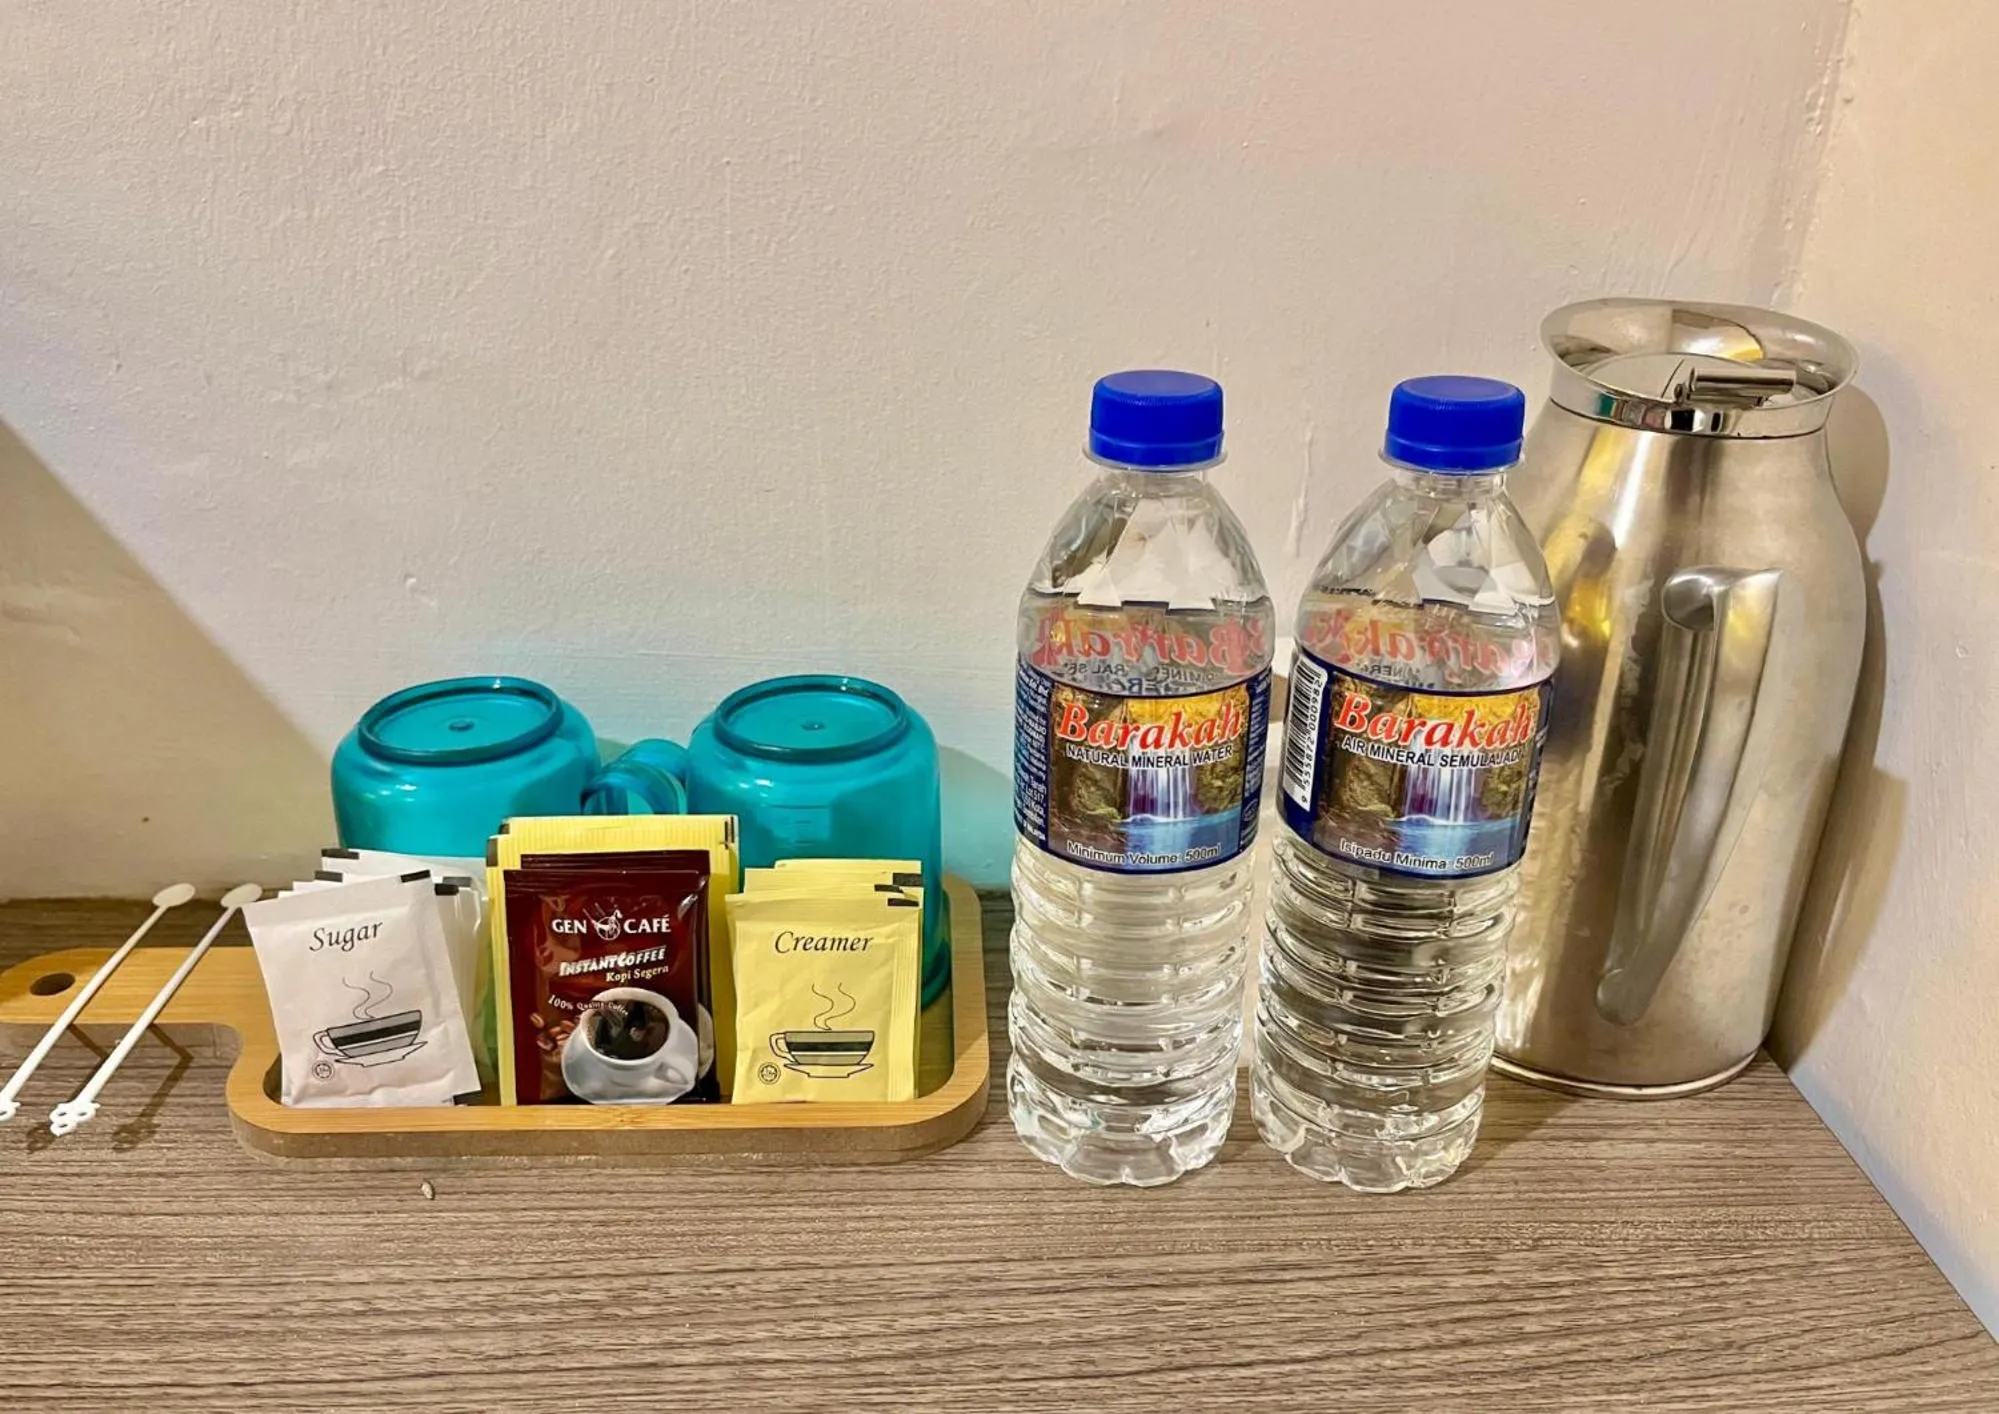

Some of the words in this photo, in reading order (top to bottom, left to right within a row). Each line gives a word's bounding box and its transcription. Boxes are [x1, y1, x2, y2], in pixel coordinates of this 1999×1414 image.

[1056, 702, 1244, 752] Barakah
[1335, 693, 1536, 751] Barakah
[1066, 744, 1127, 768] NATURAL
[1131, 754, 1189, 769] MINERAL
[1192, 745, 1233, 766] WATER
[1343, 736, 1366, 753] AIR
[1369, 743, 1435, 767] MINERAL
[1067, 839, 1125, 864] Minimum
[309, 920, 384, 952] Sugar
[552, 919, 587, 934] GEN
[623, 914, 671, 934] CAFÉ
[775, 930, 875, 954] Creamer
[606, 971, 632, 983] Kopi
[634, 965, 669, 980] Segera
[548, 994, 574, 1010] 100%
